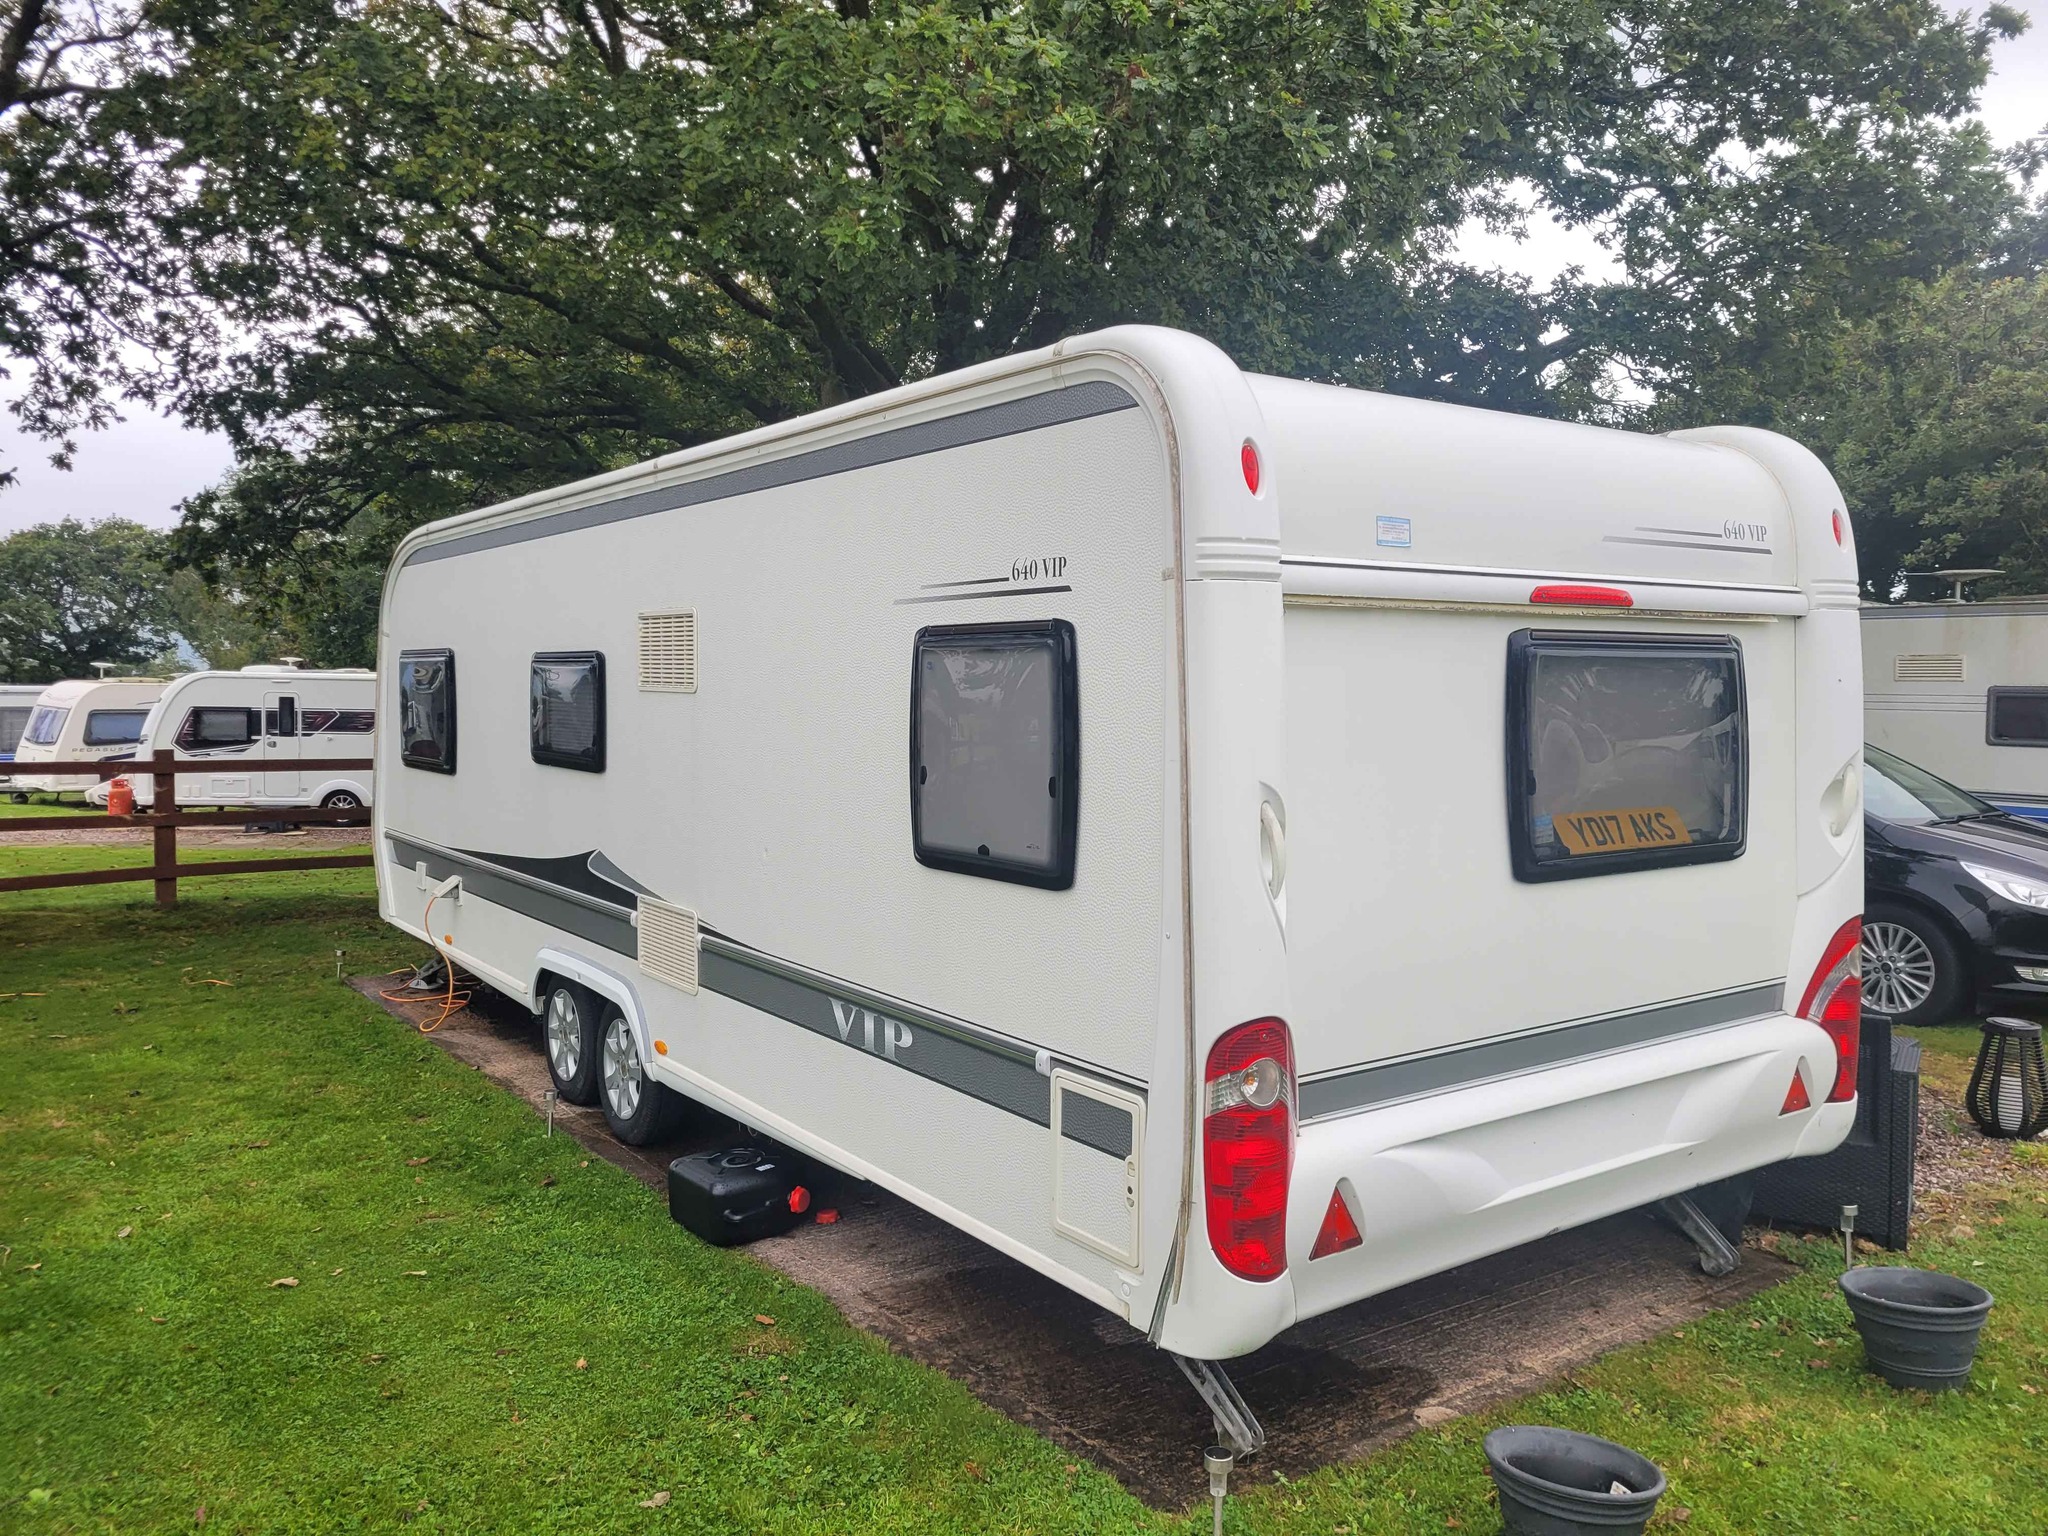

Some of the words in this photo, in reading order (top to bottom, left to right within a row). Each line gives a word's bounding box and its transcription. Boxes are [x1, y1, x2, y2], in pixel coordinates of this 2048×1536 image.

[1723, 519, 1746, 540] 640
[1747, 524, 1768, 542] VIP
[1011, 557, 1038, 581] 640
[1042, 556, 1067, 578] VIP
[1567, 814, 1625, 848] YD17
[1628, 811, 1677, 844] AKS
[827, 996, 913, 1063] VIP
